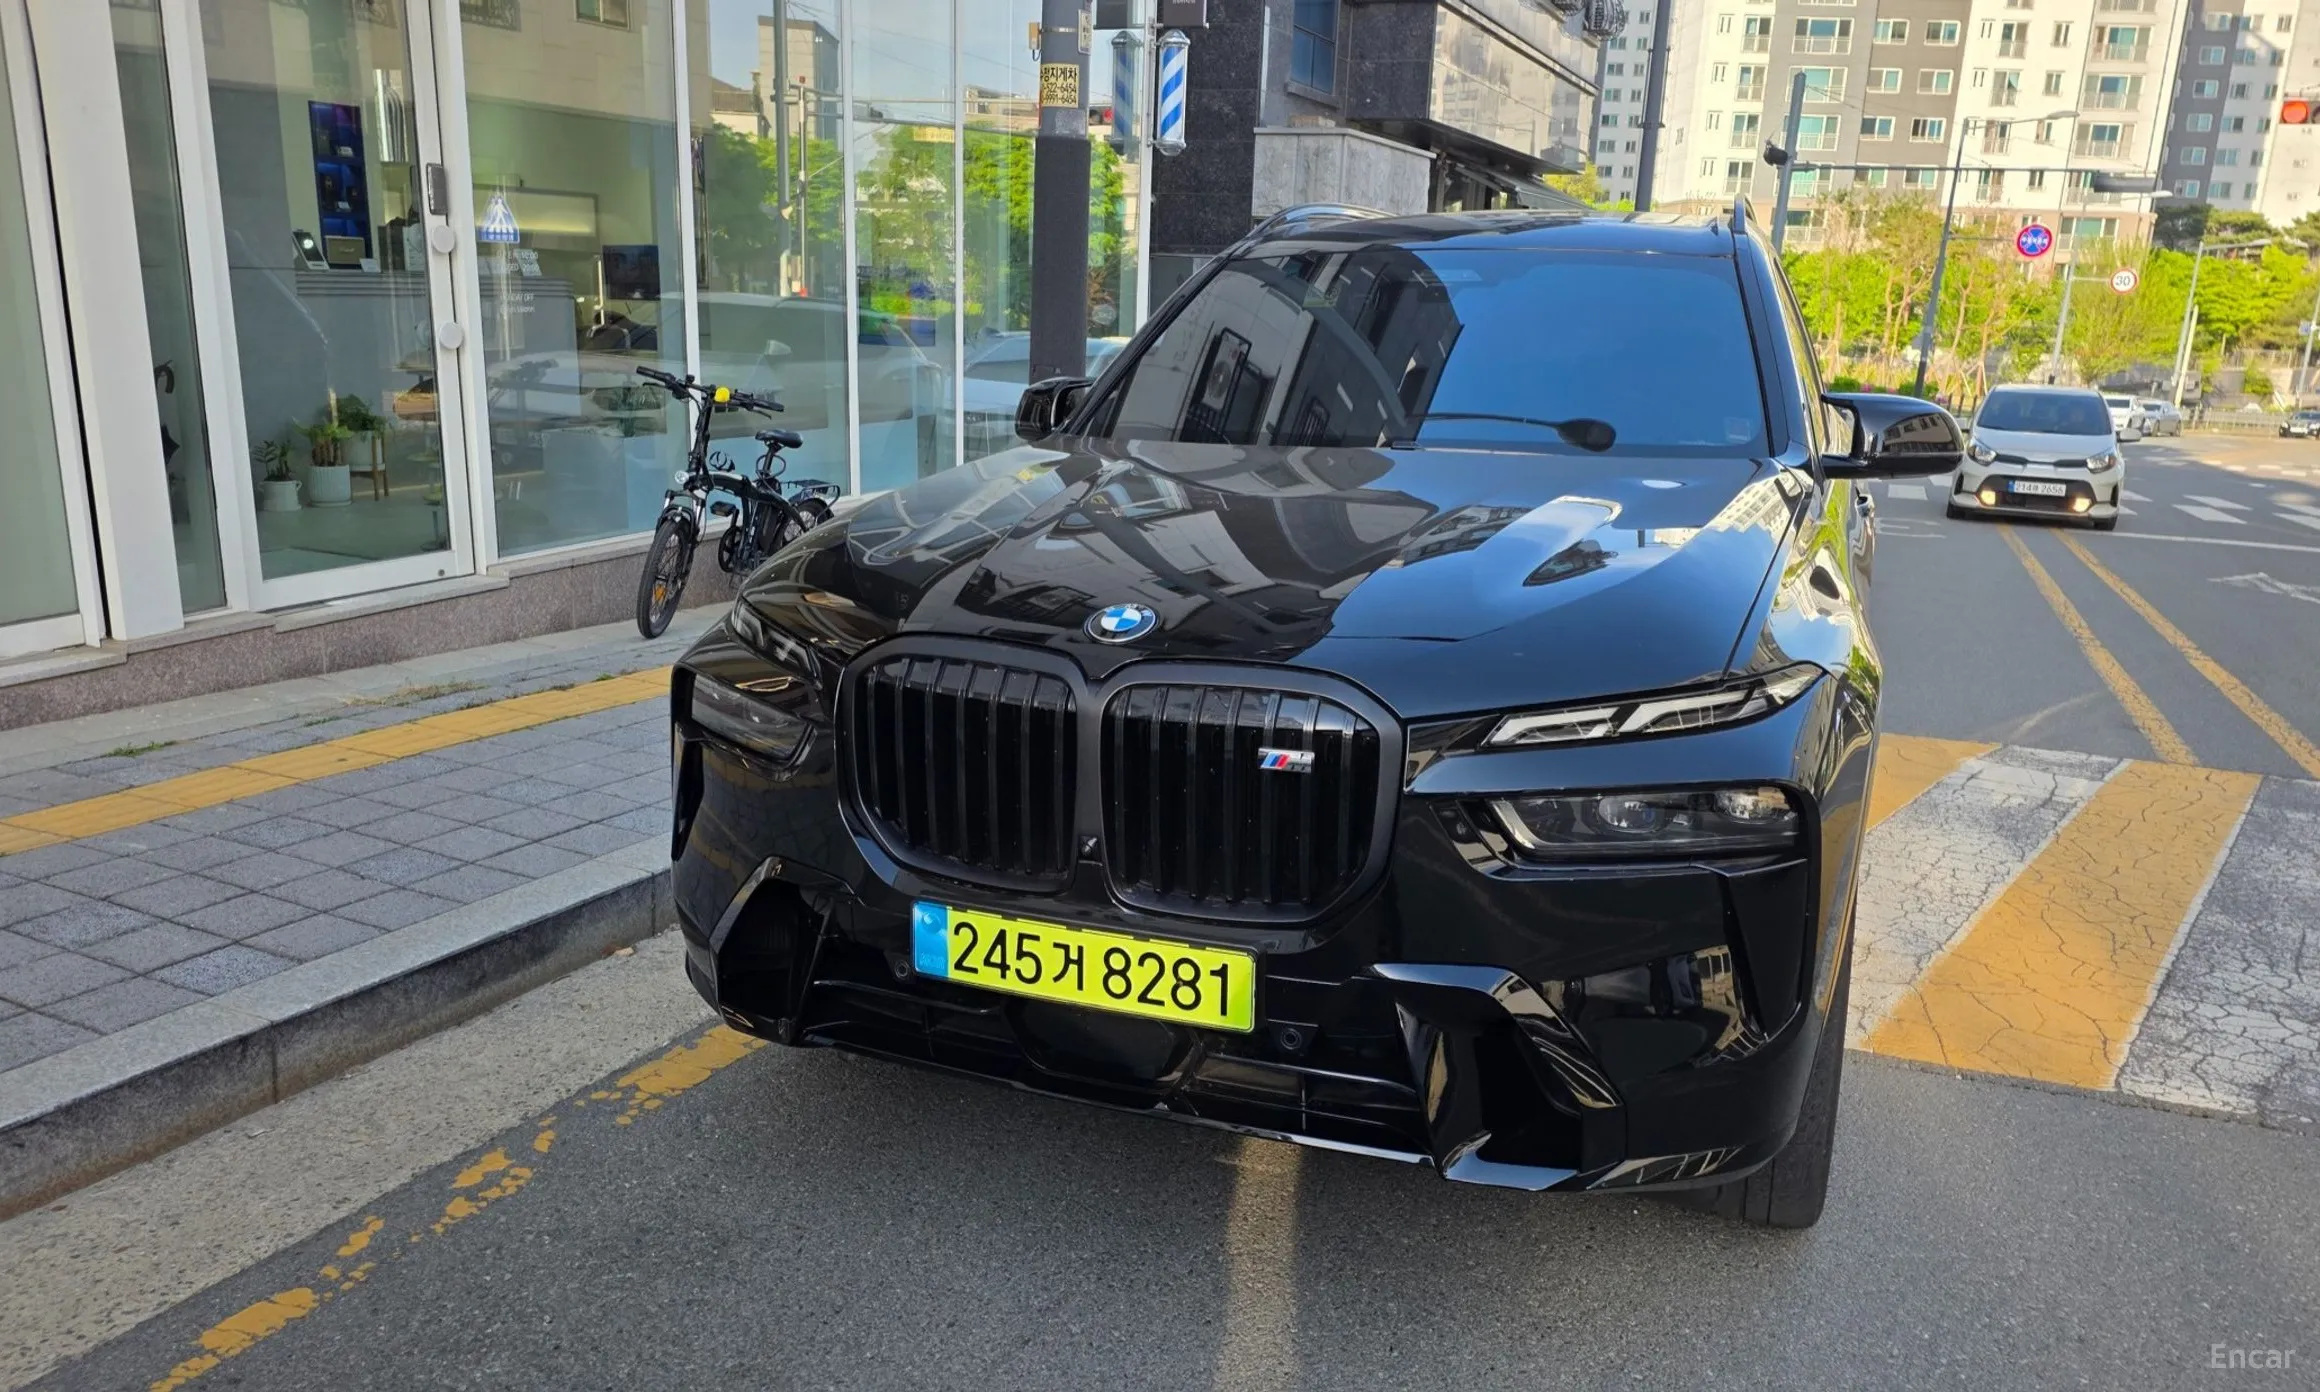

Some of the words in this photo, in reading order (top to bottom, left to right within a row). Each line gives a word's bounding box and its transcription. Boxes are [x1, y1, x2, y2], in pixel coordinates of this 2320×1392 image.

[2115, 275, 2131, 287] 30
[953, 921, 1084, 991] 245거
[1102, 946, 1229, 1017] 8281
